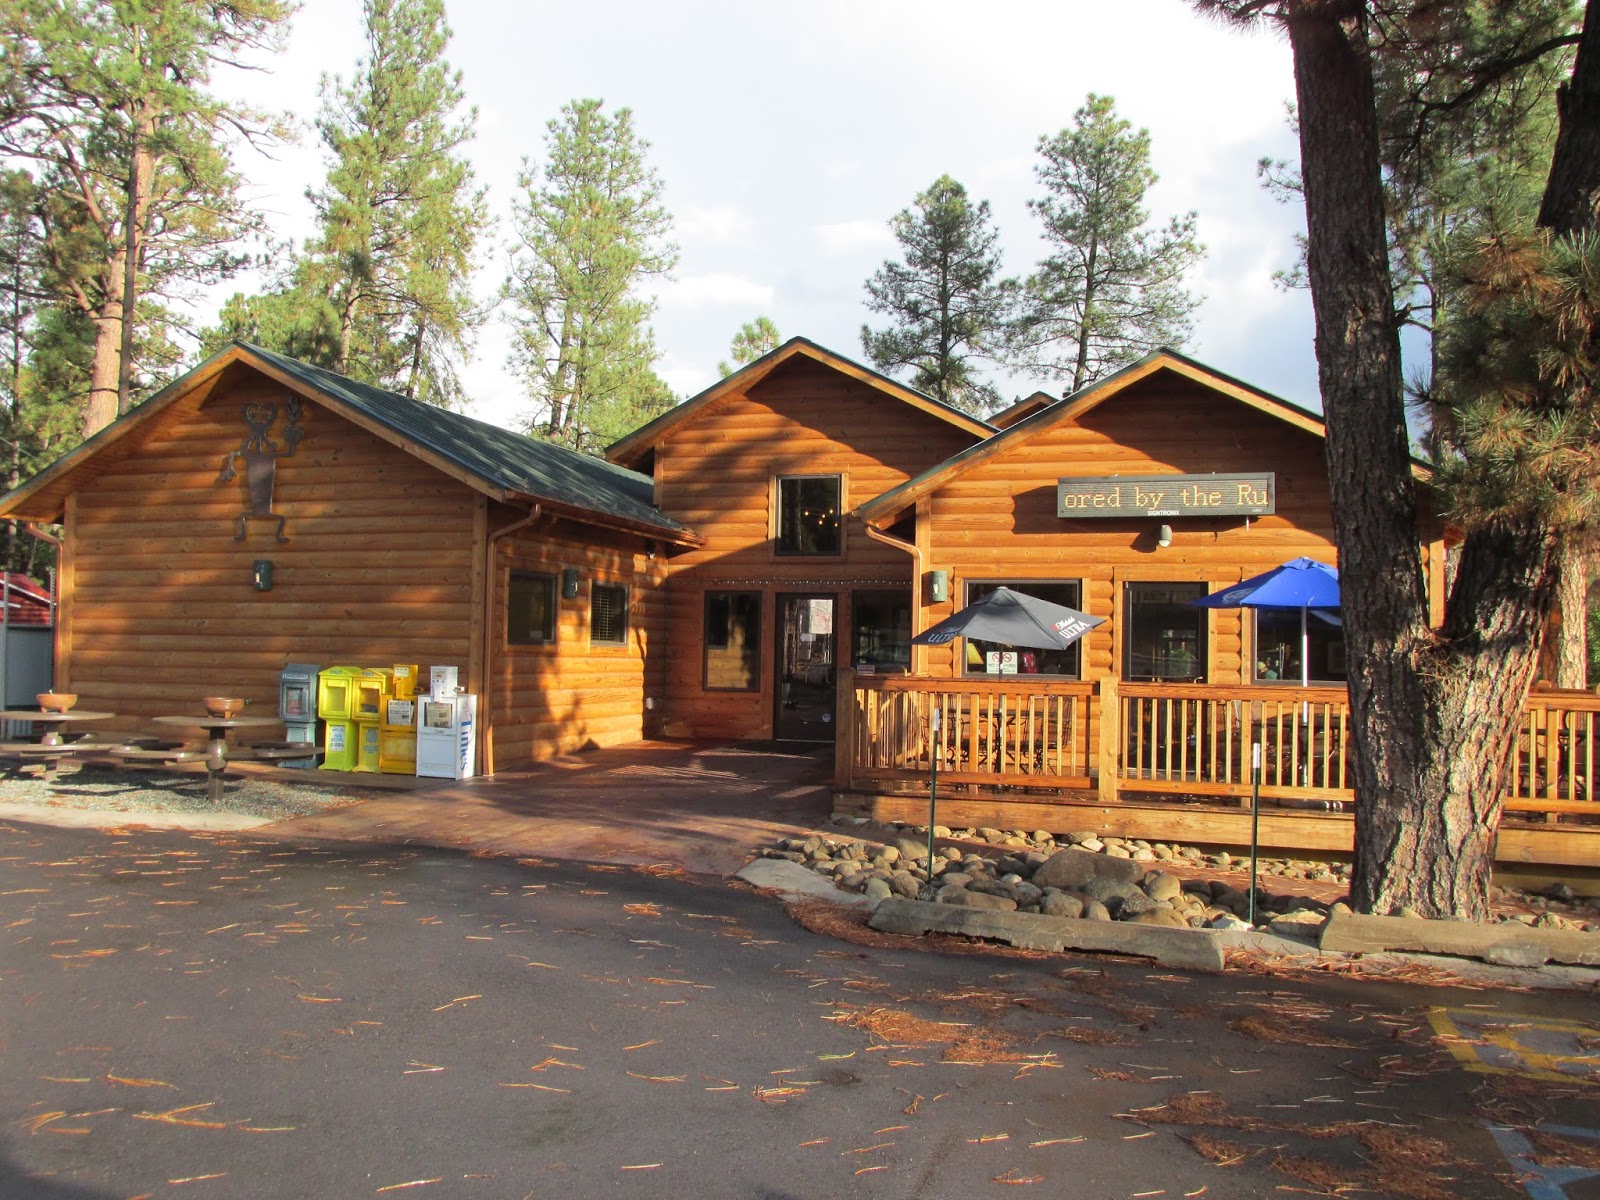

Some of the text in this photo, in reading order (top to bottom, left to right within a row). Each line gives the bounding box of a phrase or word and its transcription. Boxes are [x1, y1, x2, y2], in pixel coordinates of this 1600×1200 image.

[1064, 484, 1269, 510] ored by the Ru
[1059, 620, 1091, 639] ULTRA
[461, 713, 473, 771] Times
